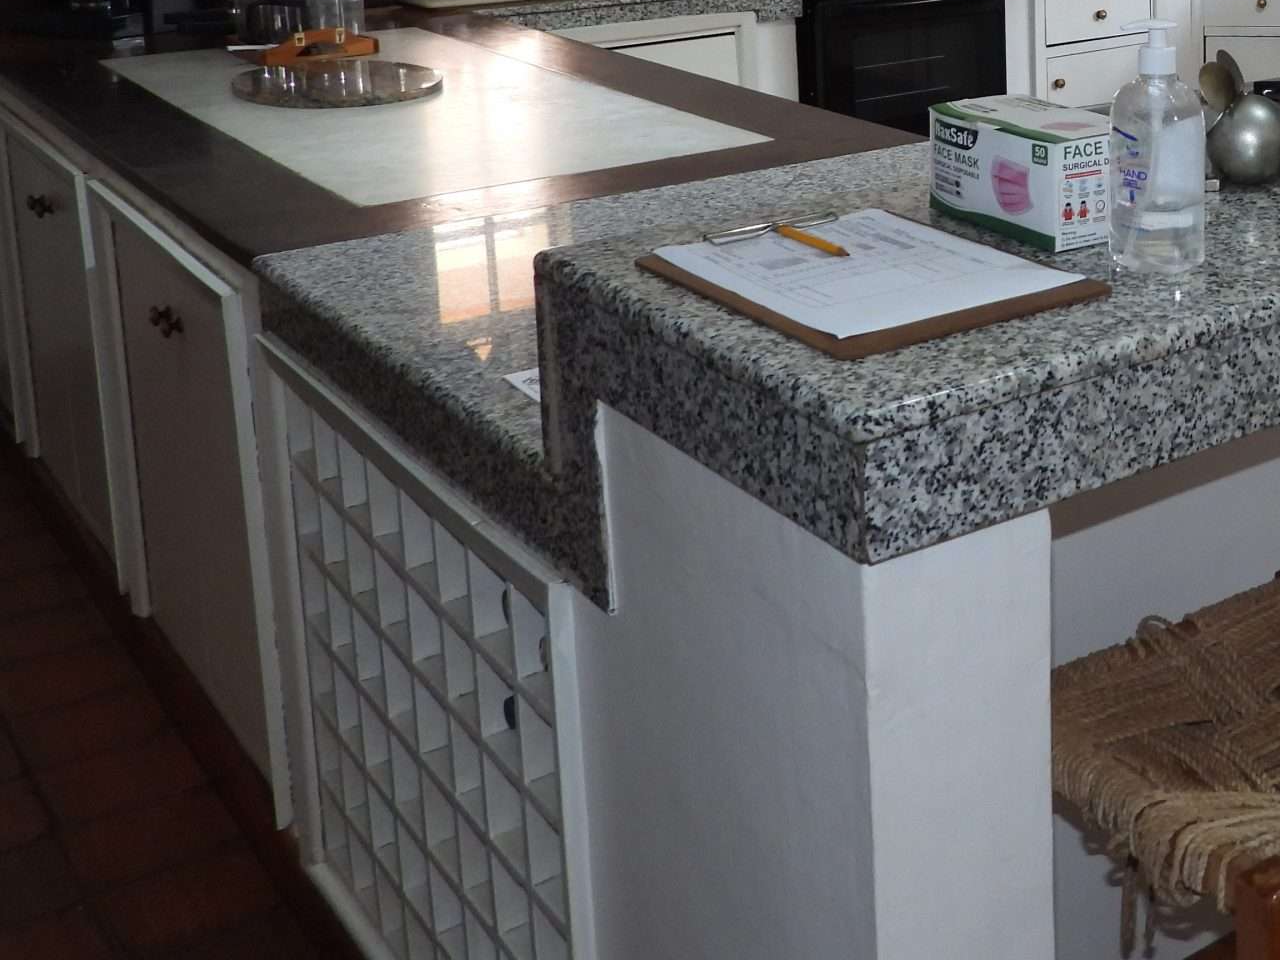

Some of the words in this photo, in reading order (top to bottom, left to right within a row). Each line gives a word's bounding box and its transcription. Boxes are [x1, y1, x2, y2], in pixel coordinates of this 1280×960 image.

[934, 143, 953, 161] FACE
[954, 151, 980, 170] MASK
[1035, 146, 1046, 158] 50
[1064, 141, 1103, 160] FACE
[1062, 159, 1104, 172] SURGICAL
